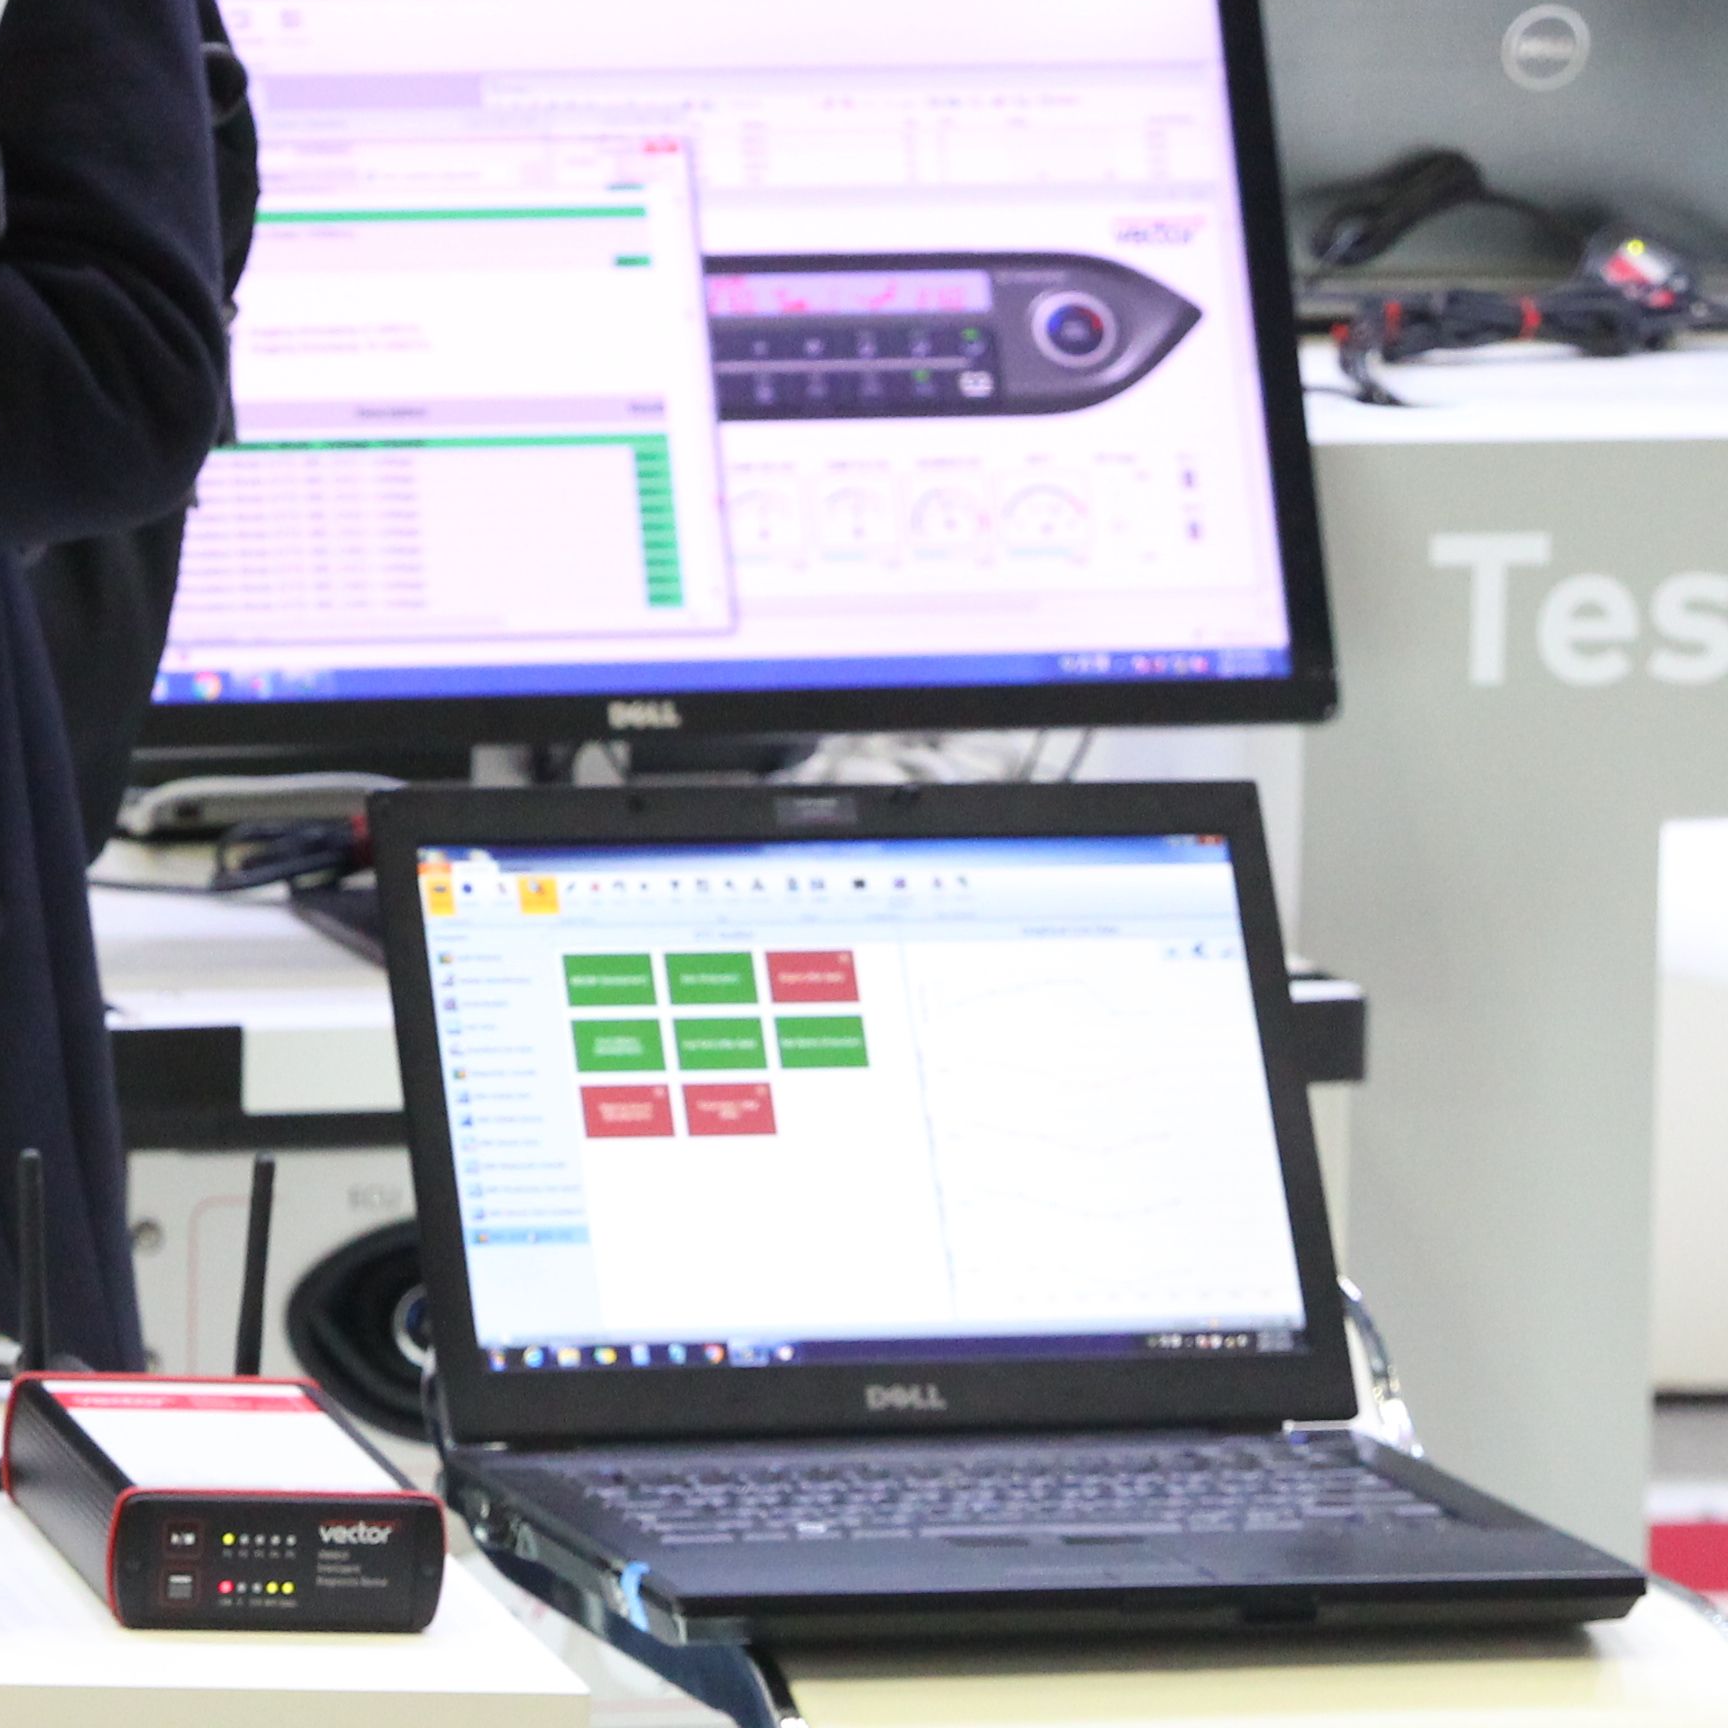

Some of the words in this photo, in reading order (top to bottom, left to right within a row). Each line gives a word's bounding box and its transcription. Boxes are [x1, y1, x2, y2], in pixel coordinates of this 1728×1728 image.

[1428, 530, 1728, 687] Tes
[610, 699, 681, 729] DELL
[865, 1382, 947, 1412] DELL
[318, 1520, 393, 1545] vector
